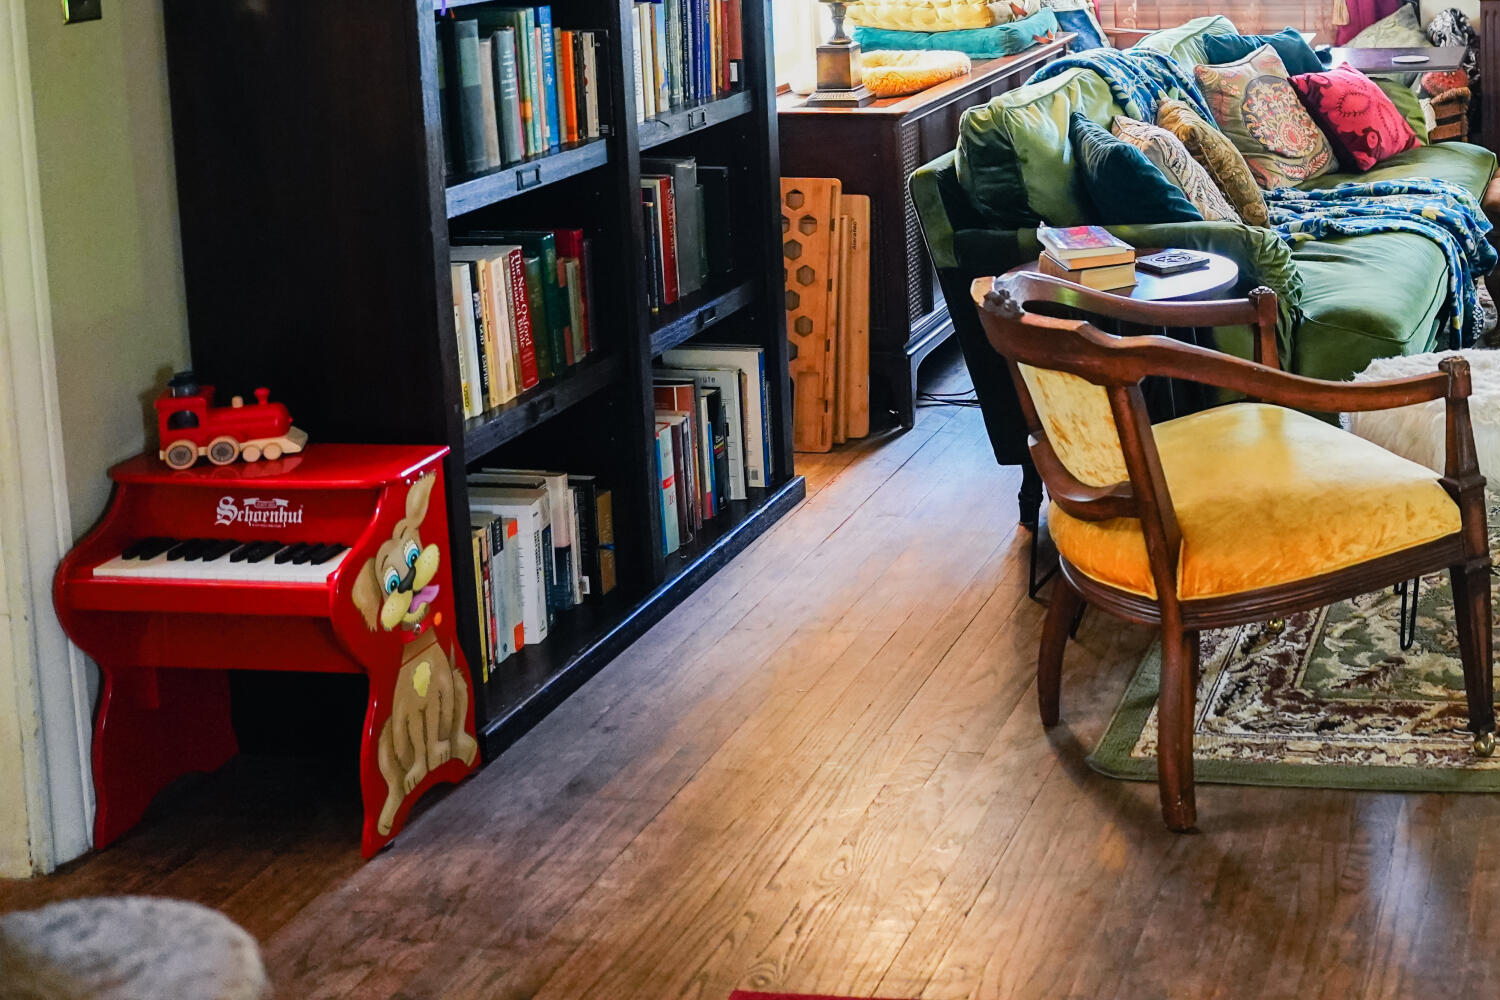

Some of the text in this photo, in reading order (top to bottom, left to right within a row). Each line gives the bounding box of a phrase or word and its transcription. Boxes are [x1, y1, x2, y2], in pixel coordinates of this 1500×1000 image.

[510, 255, 521, 316] Annotated
[517, 318, 525, 349] Bible
[514, 251, 532, 346] The New Oxford
[214, 496, 303, 528] Schoenhut
